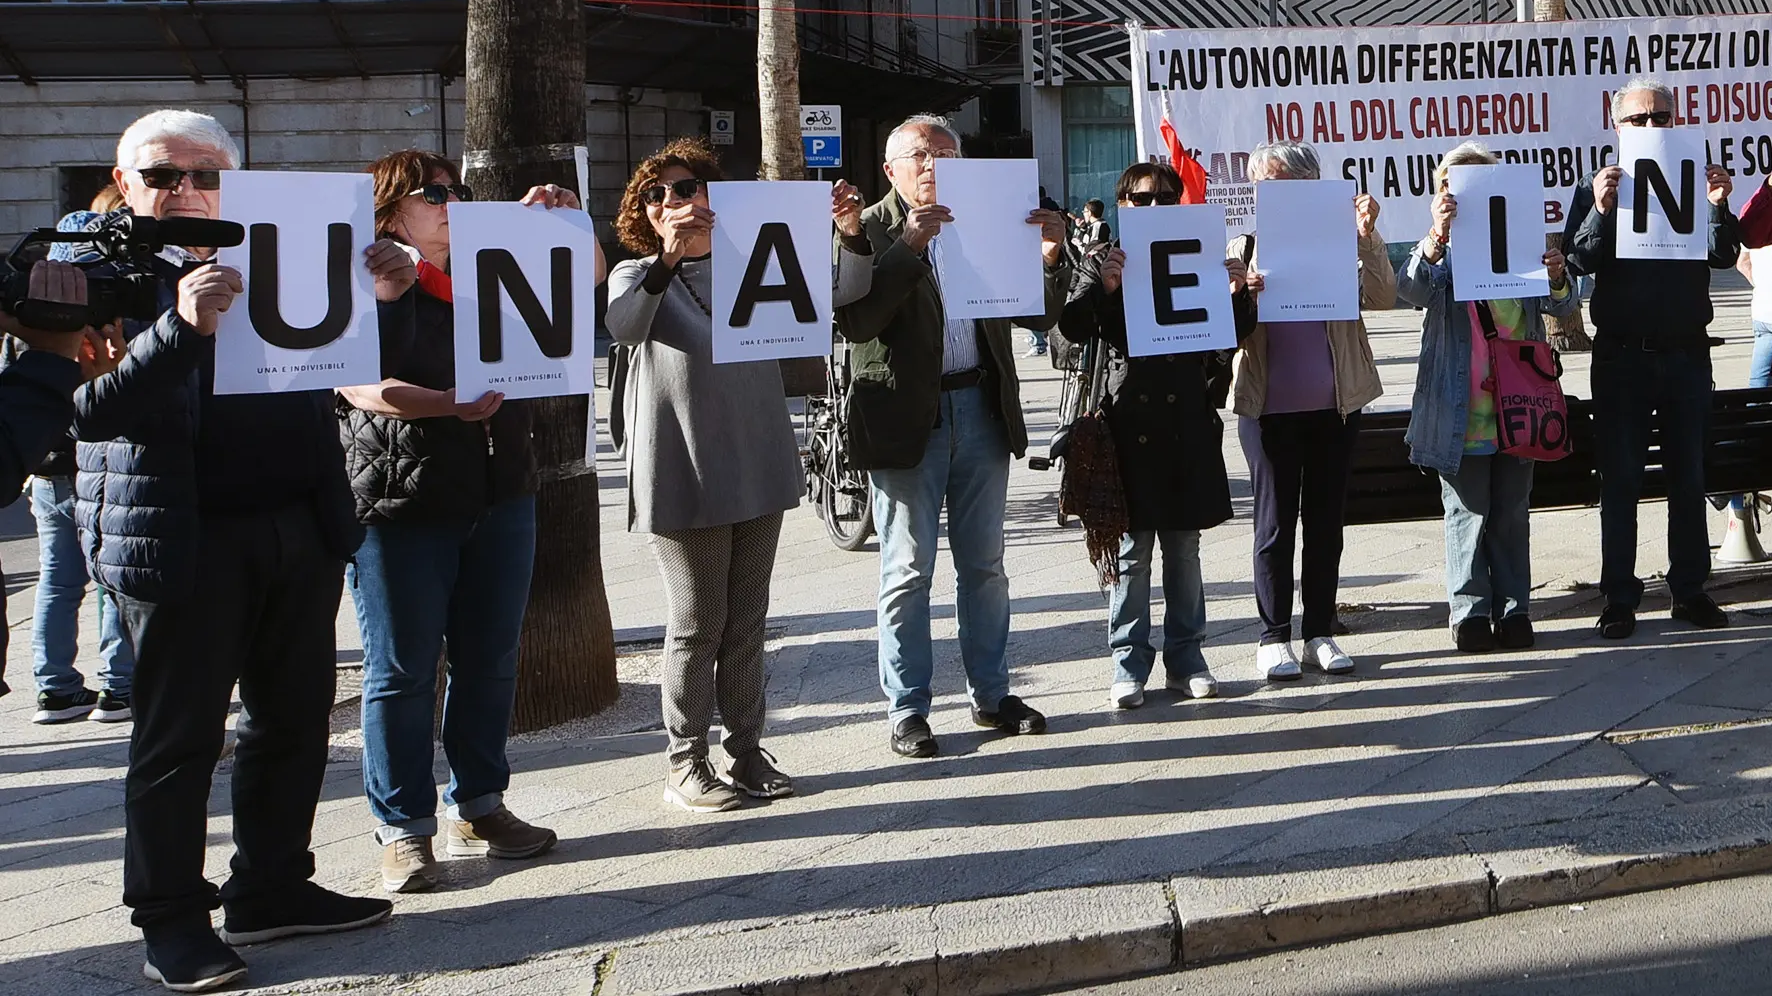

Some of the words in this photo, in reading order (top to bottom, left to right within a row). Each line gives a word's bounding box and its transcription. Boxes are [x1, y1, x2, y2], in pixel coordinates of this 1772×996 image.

[1146, 45, 1349, 92] L'AUTONOMIA
[1357, 37, 1576, 84] DIFFERENZIATA
[1584, 36, 1617, 75] FA
[1624, 35, 1641, 74] A
[1648, 32, 1721, 73] PEZZI
[1728, 32, 1736, 68] I
[1265, 102, 1304, 145] NO
[1312, 101, 1344, 143] AL
[1350, 98, 1403, 141] DDL
[1409, 92, 1549, 138] CALDEROLI
[813, 140, 826, 154] P
[1228, 187, 1236, 196] DI
[1237, 186, 1254, 195] OGNI
[1384, 156, 1401, 197] A
[1633, 158, 1695, 234] N
[1251, 207, 1256, 215] E
[1489, 195, 1509, 273] I
[248, 223, 352, 349] U
[729, 222, 818, 327] A
[1150, 239, 1208, 326] E
[476, 247, 572, 363] N
[763, 336, 805, 345] INDIVISIBILE
[1173, 332, 1211, 341] INDIVISIBILE
[257, 366, 278, 374] UNA
[291, 362, 345, 373] INDIVISIBILE
[488, 376, 505, 384] UNA
[515, 372, 563, 383] INDIVISIBILE
[1501, 394, 1553, 409] FIORUCCI
